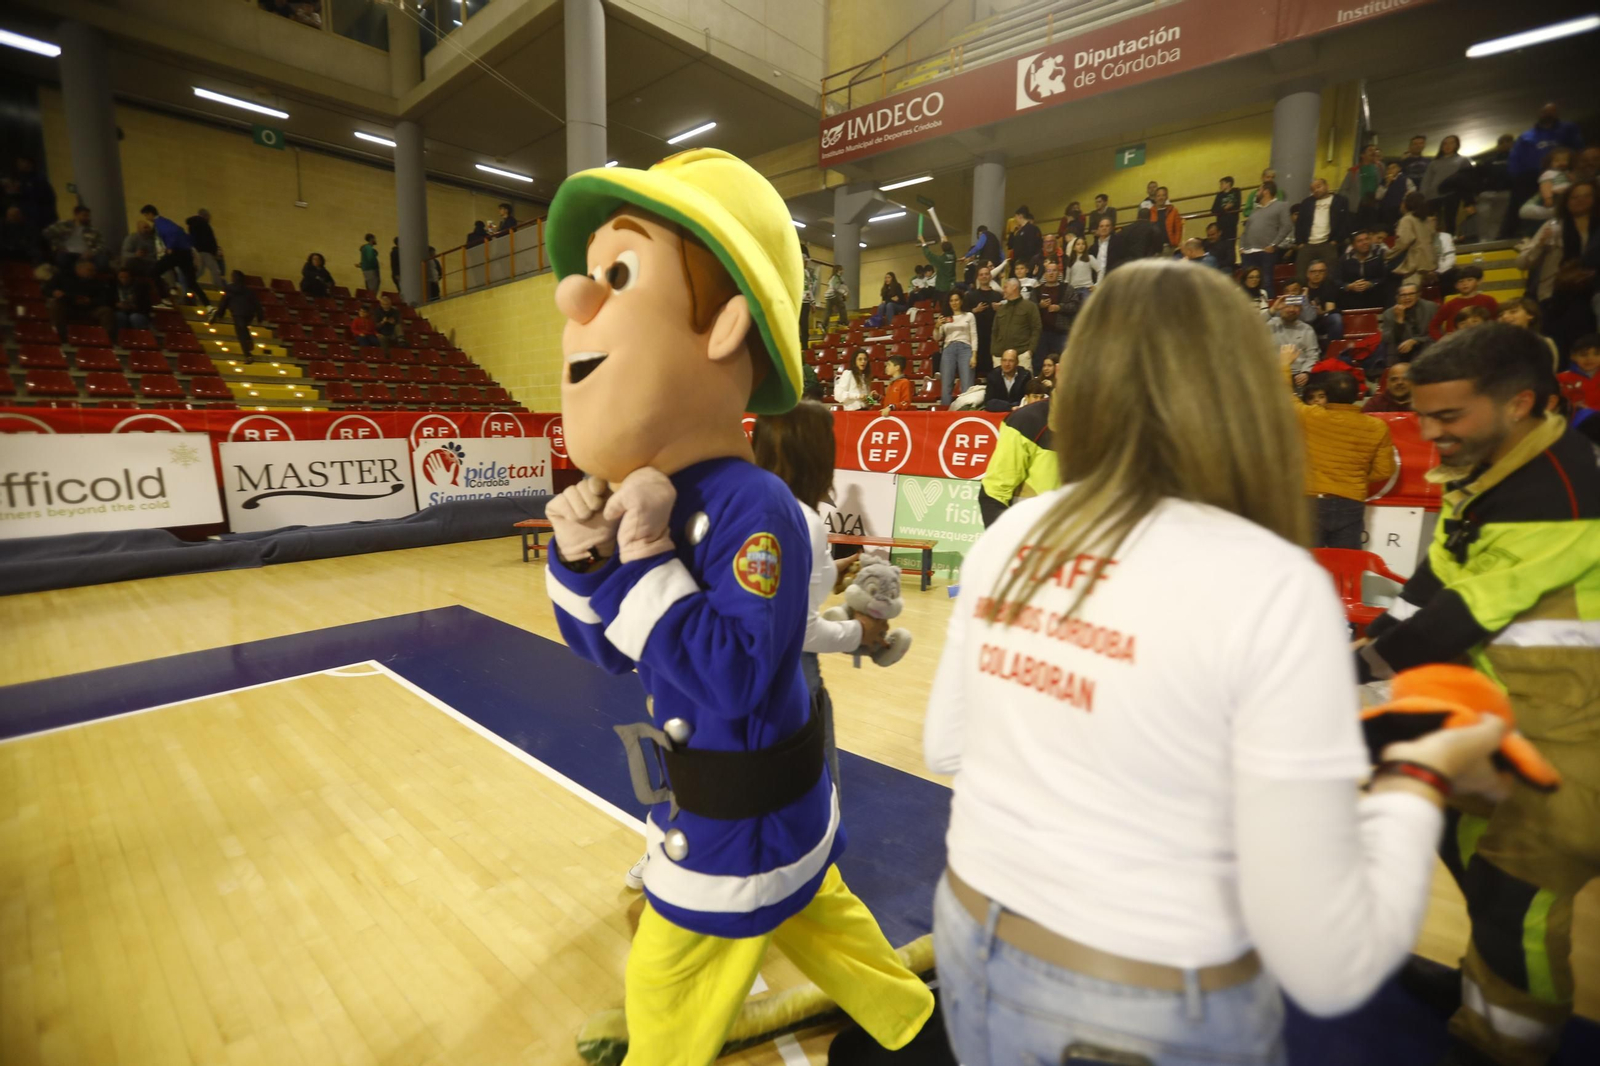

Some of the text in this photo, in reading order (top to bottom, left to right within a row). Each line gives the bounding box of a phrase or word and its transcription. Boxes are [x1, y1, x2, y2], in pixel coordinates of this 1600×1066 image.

[1074, 26, 1181, 69] Diputación
[1073, 47, 1181, 88] de Córdoba
[847, 91, 945, 141] IMDECO
[821, 148, 846, 160] Instituto
[845, 139, 875, 153] Municipal
[874, 136, 884, 145] de
[883, 128, 913, 143] Deportes
[1123, 148, 1137, 165] F
[421, 426, 449, 437] RF
[490, 421, 515, 432] RF
[870, 431, 901, 445] RF
[955, 433, 990, 449] RF
[868, 448, 899, 463] EF
[951, 452, 988, 467] EF
[233, 458, 403, 493] MASTER
[464, 459, 546, 488] pidetaxi
[0, 466, 167, 508] fficold
[46, 503, 107, 518] beyond
[111, 502, 136, 513] the
[139, 500, 171, 511] cold
[899, 525, 985, 543] www.vazquezf
[896, 556, 950, 571] FISIOTAPIA
[979, 643, 1096, 713] COLABORAN
